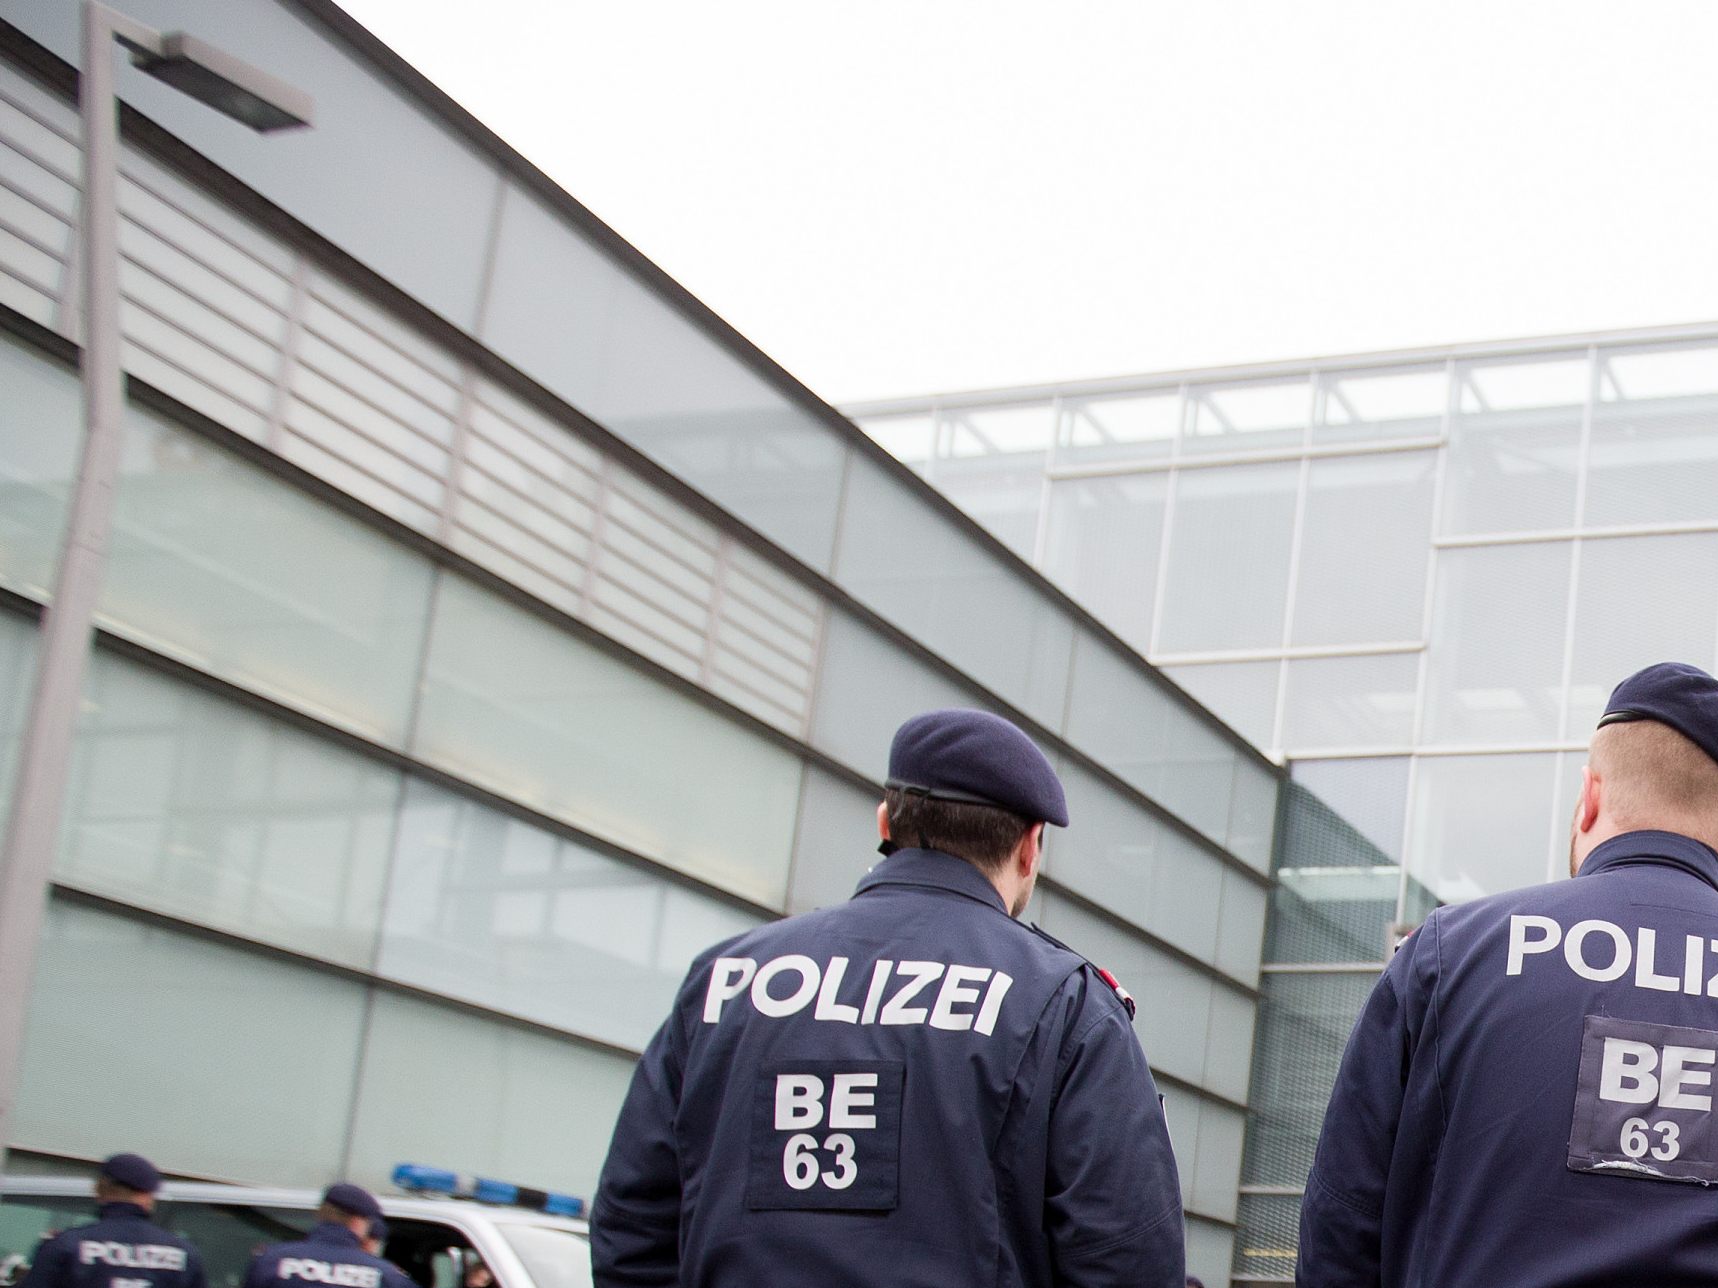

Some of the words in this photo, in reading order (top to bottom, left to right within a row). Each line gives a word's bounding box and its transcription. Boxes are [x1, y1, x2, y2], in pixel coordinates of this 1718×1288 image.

[703, 954, 1013, 1036] POLIZEI
[774, 1073, 878, 1131] BE
[1599, 1037, 1715, 1111] BE
[783, 1133, 857, 1190] 63
[1619, 1118, 1680, 1161] 63
